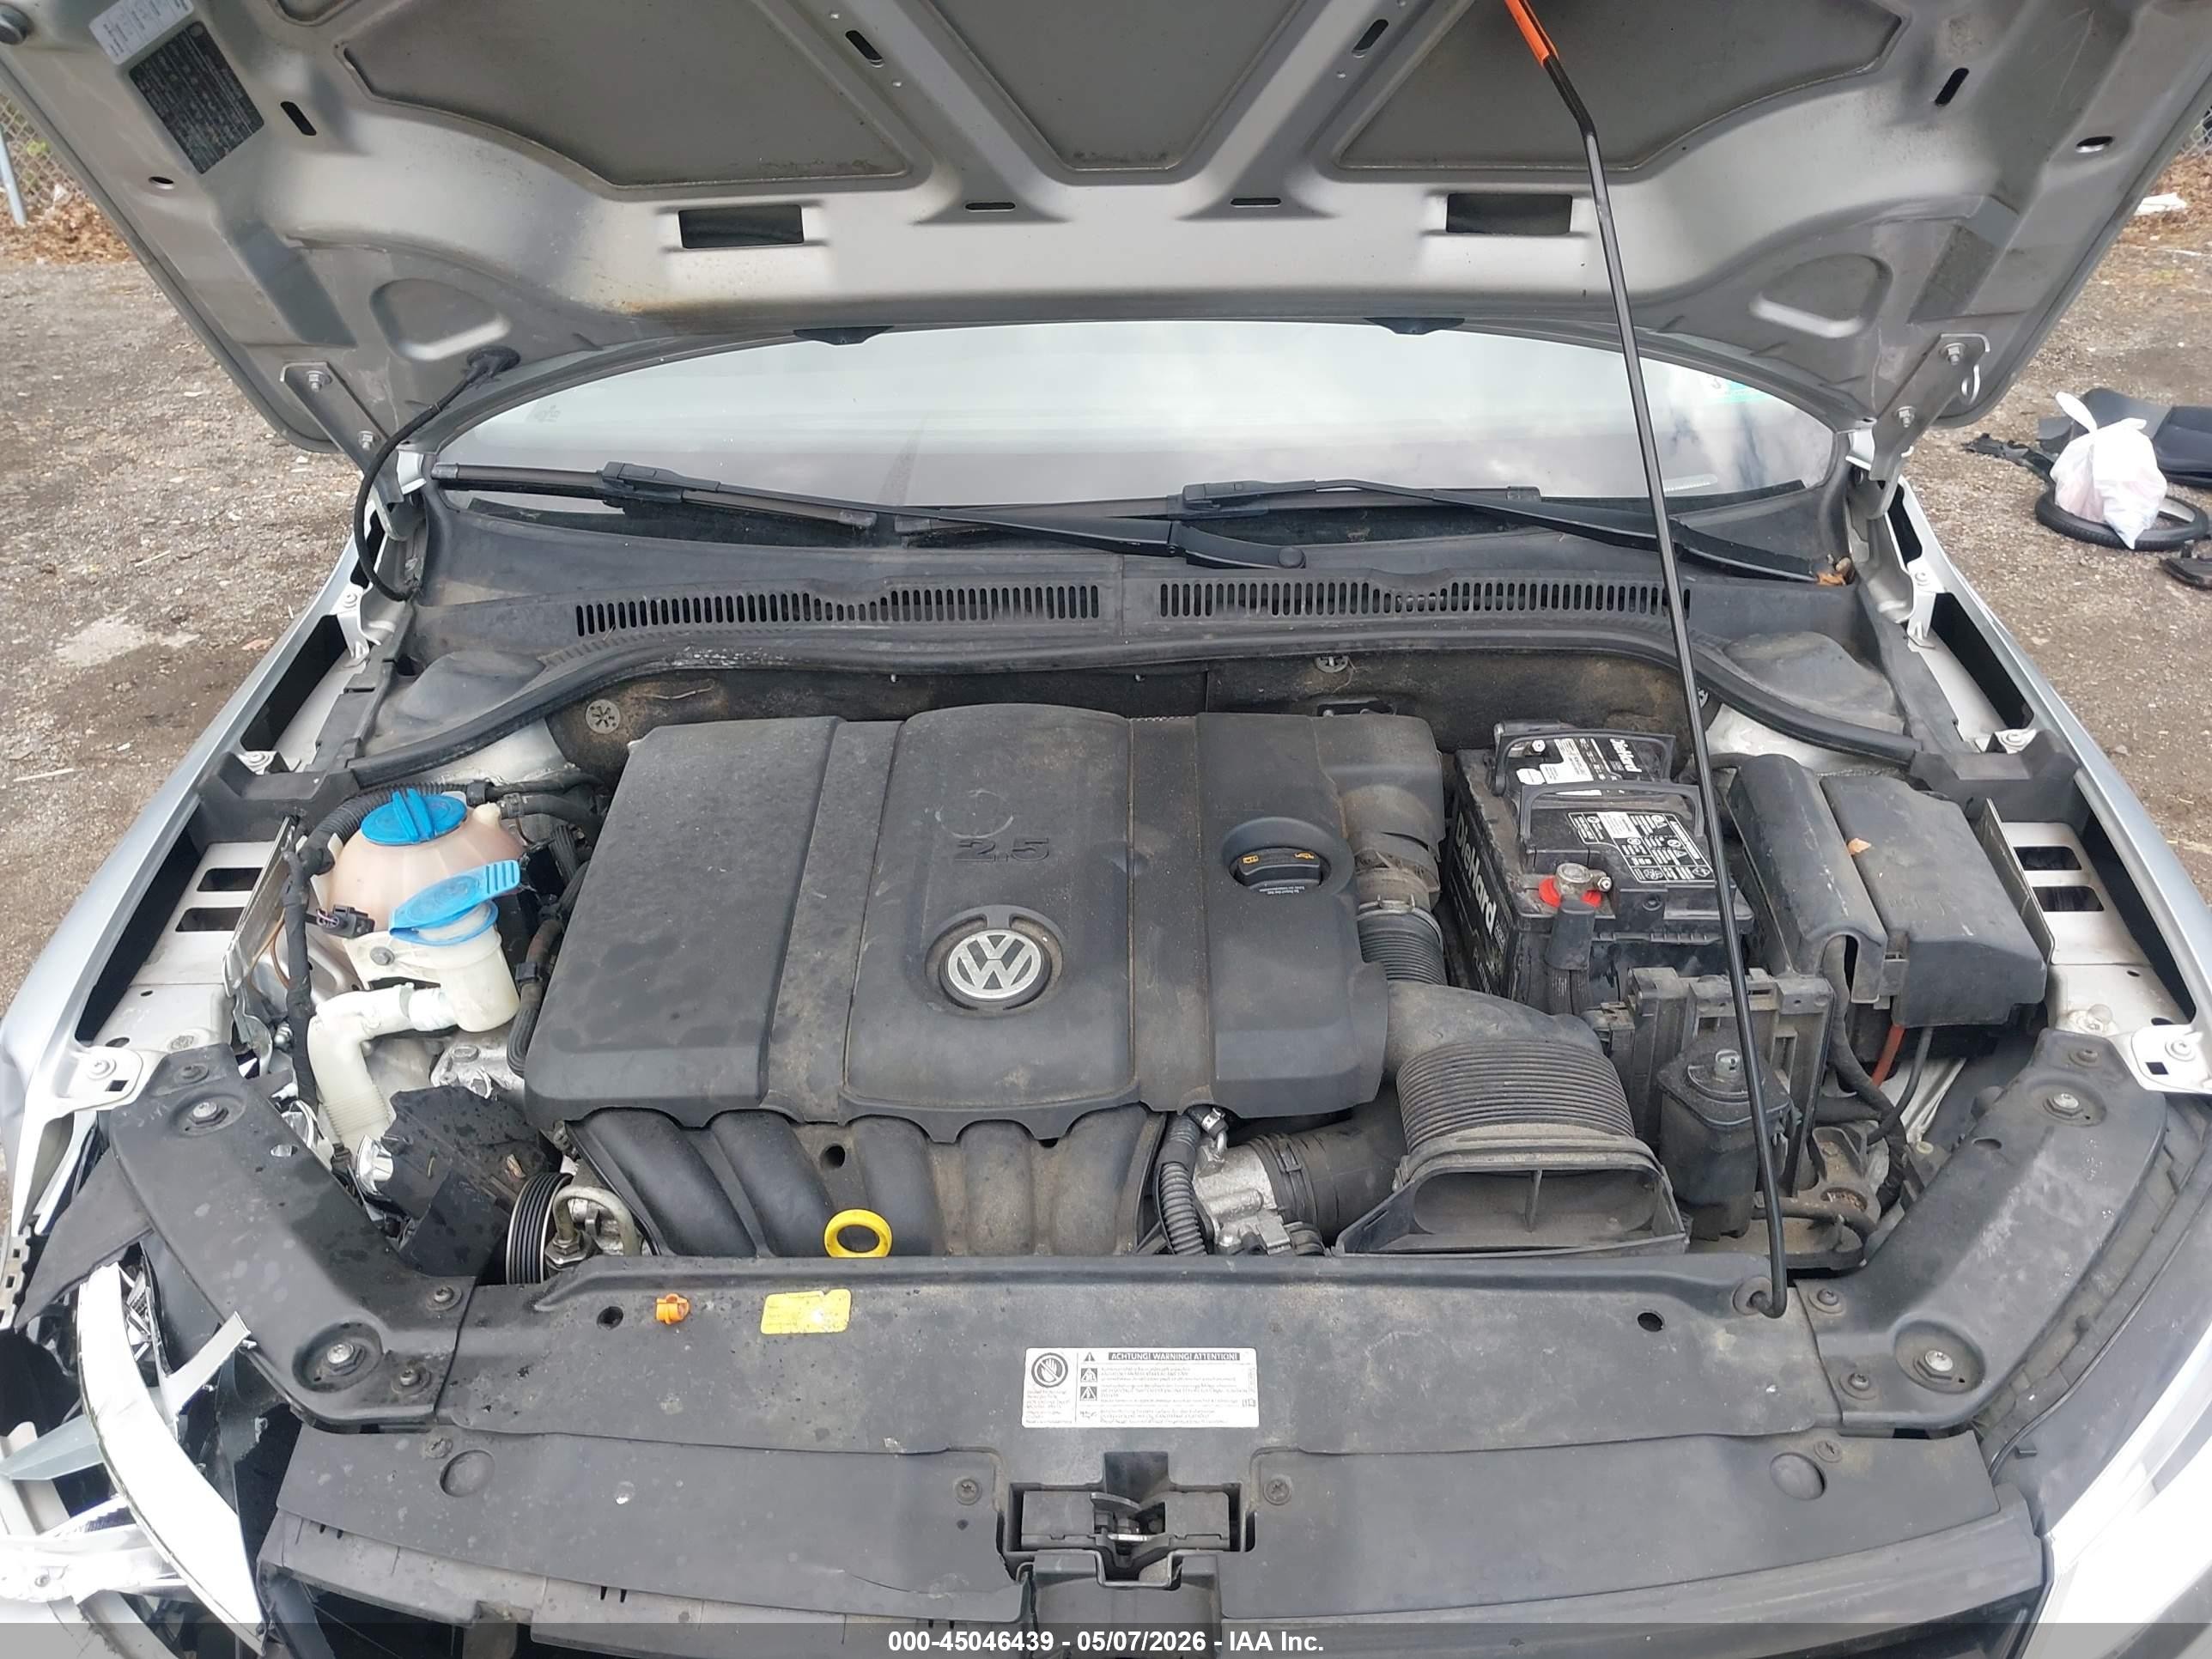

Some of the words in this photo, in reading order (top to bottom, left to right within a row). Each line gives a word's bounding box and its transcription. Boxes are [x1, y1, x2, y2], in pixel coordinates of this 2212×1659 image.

[954, 838, 1049, 863] 2.5
[1455, 811, 1497, 939] DieHard
[948, 929, 1042, 999] VW
[1111, 1352, 1151, 1361] ACHTUNG!
[1152, 1352, 1192, 1361] WARNING!
[1194, 1352, 1237, 1361] ATTENTION!
